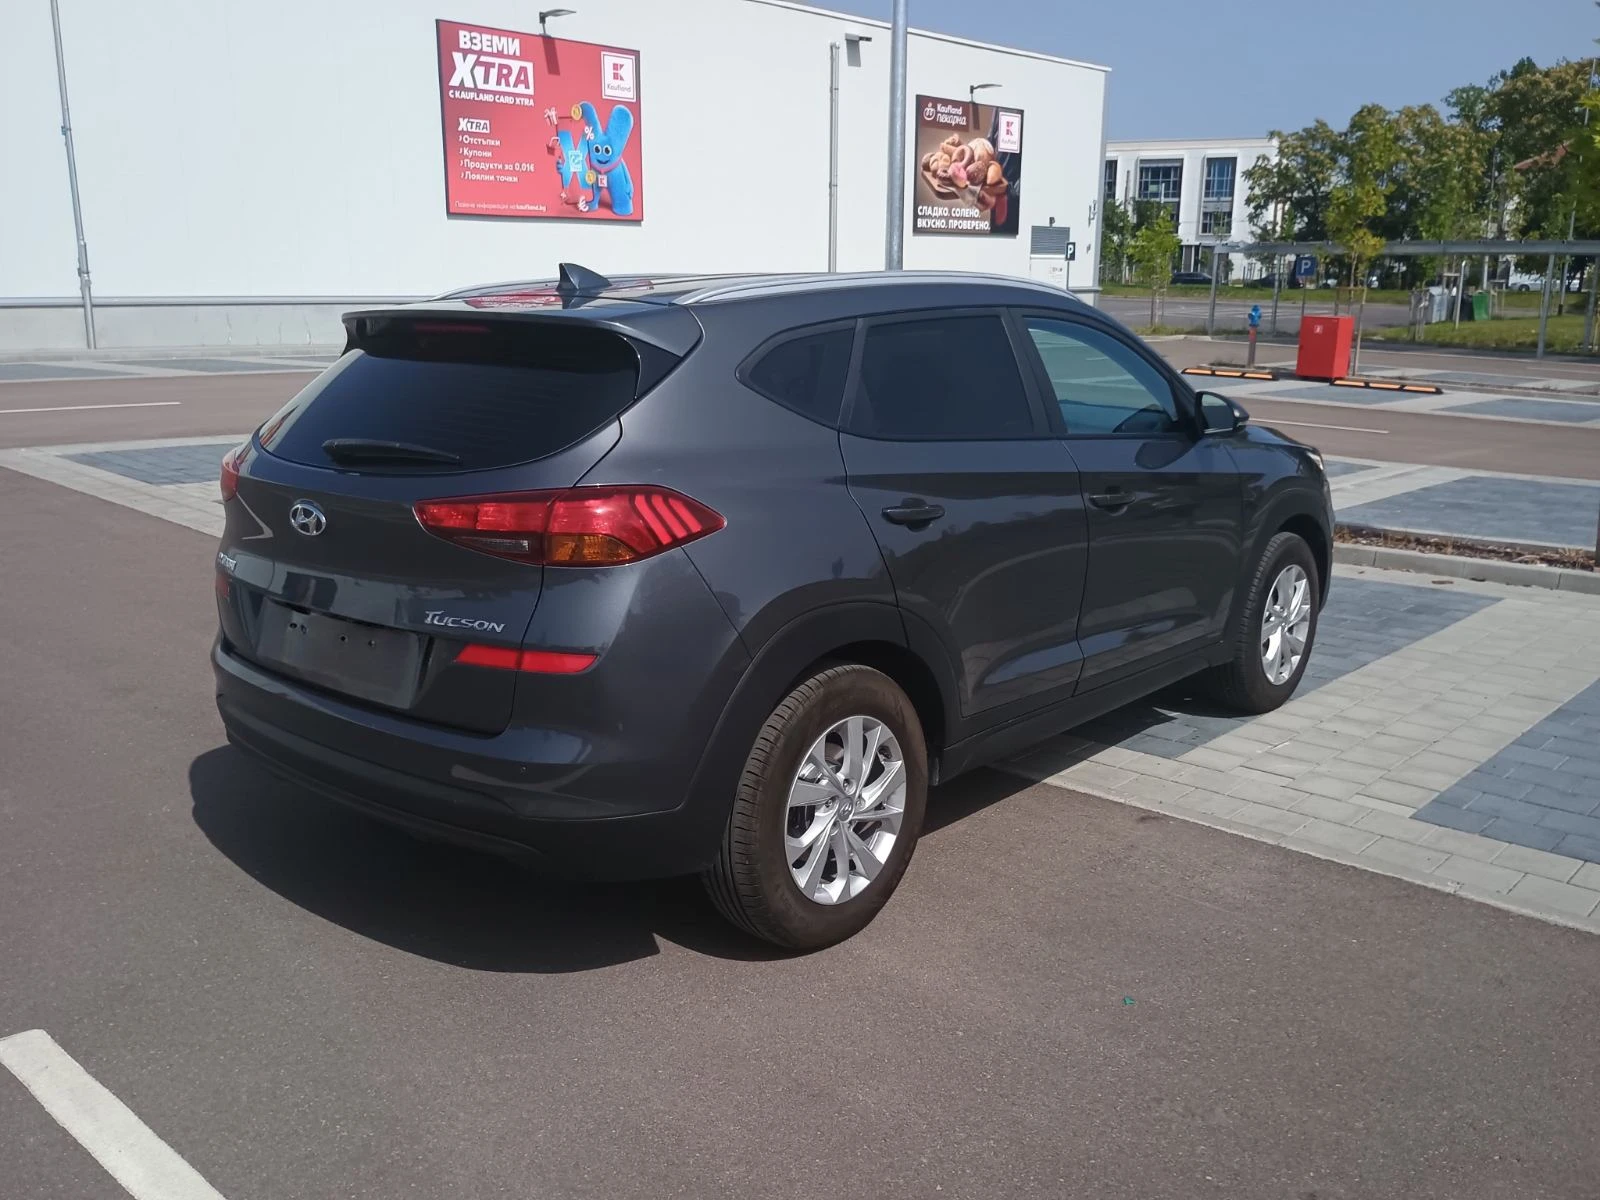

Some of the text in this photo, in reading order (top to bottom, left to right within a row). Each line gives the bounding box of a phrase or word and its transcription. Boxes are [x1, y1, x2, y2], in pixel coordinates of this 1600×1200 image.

[458, 29, 521, 56] ВЗЕМИ
[448, 51, 533, 93] XTRA
[454, 90, 495, 102] KAUFLAND
[495, 94, 514, 105] CARD
[515, 97, 535, 107] XTRA
[936, 103, 963, 115] Kaufland
[458, 117, 490, 133] XTRA
[584, 126, 595, 140] %
[463, 134, 501, 147] Отстъпки
[463, 147, 493, 158] Купони
[464, 159, 503, 171] Продукти
[496, 175, 519, 183] точки
[917, 205, 981, 218] СЛАДКО. СОЛЕНО.
[917, 218, 991, 231] ВКУСНО. ПРОВЕРЕНО.
[1067, 244, 1074, 259] P
[1300, 259, 1312, 274] P
